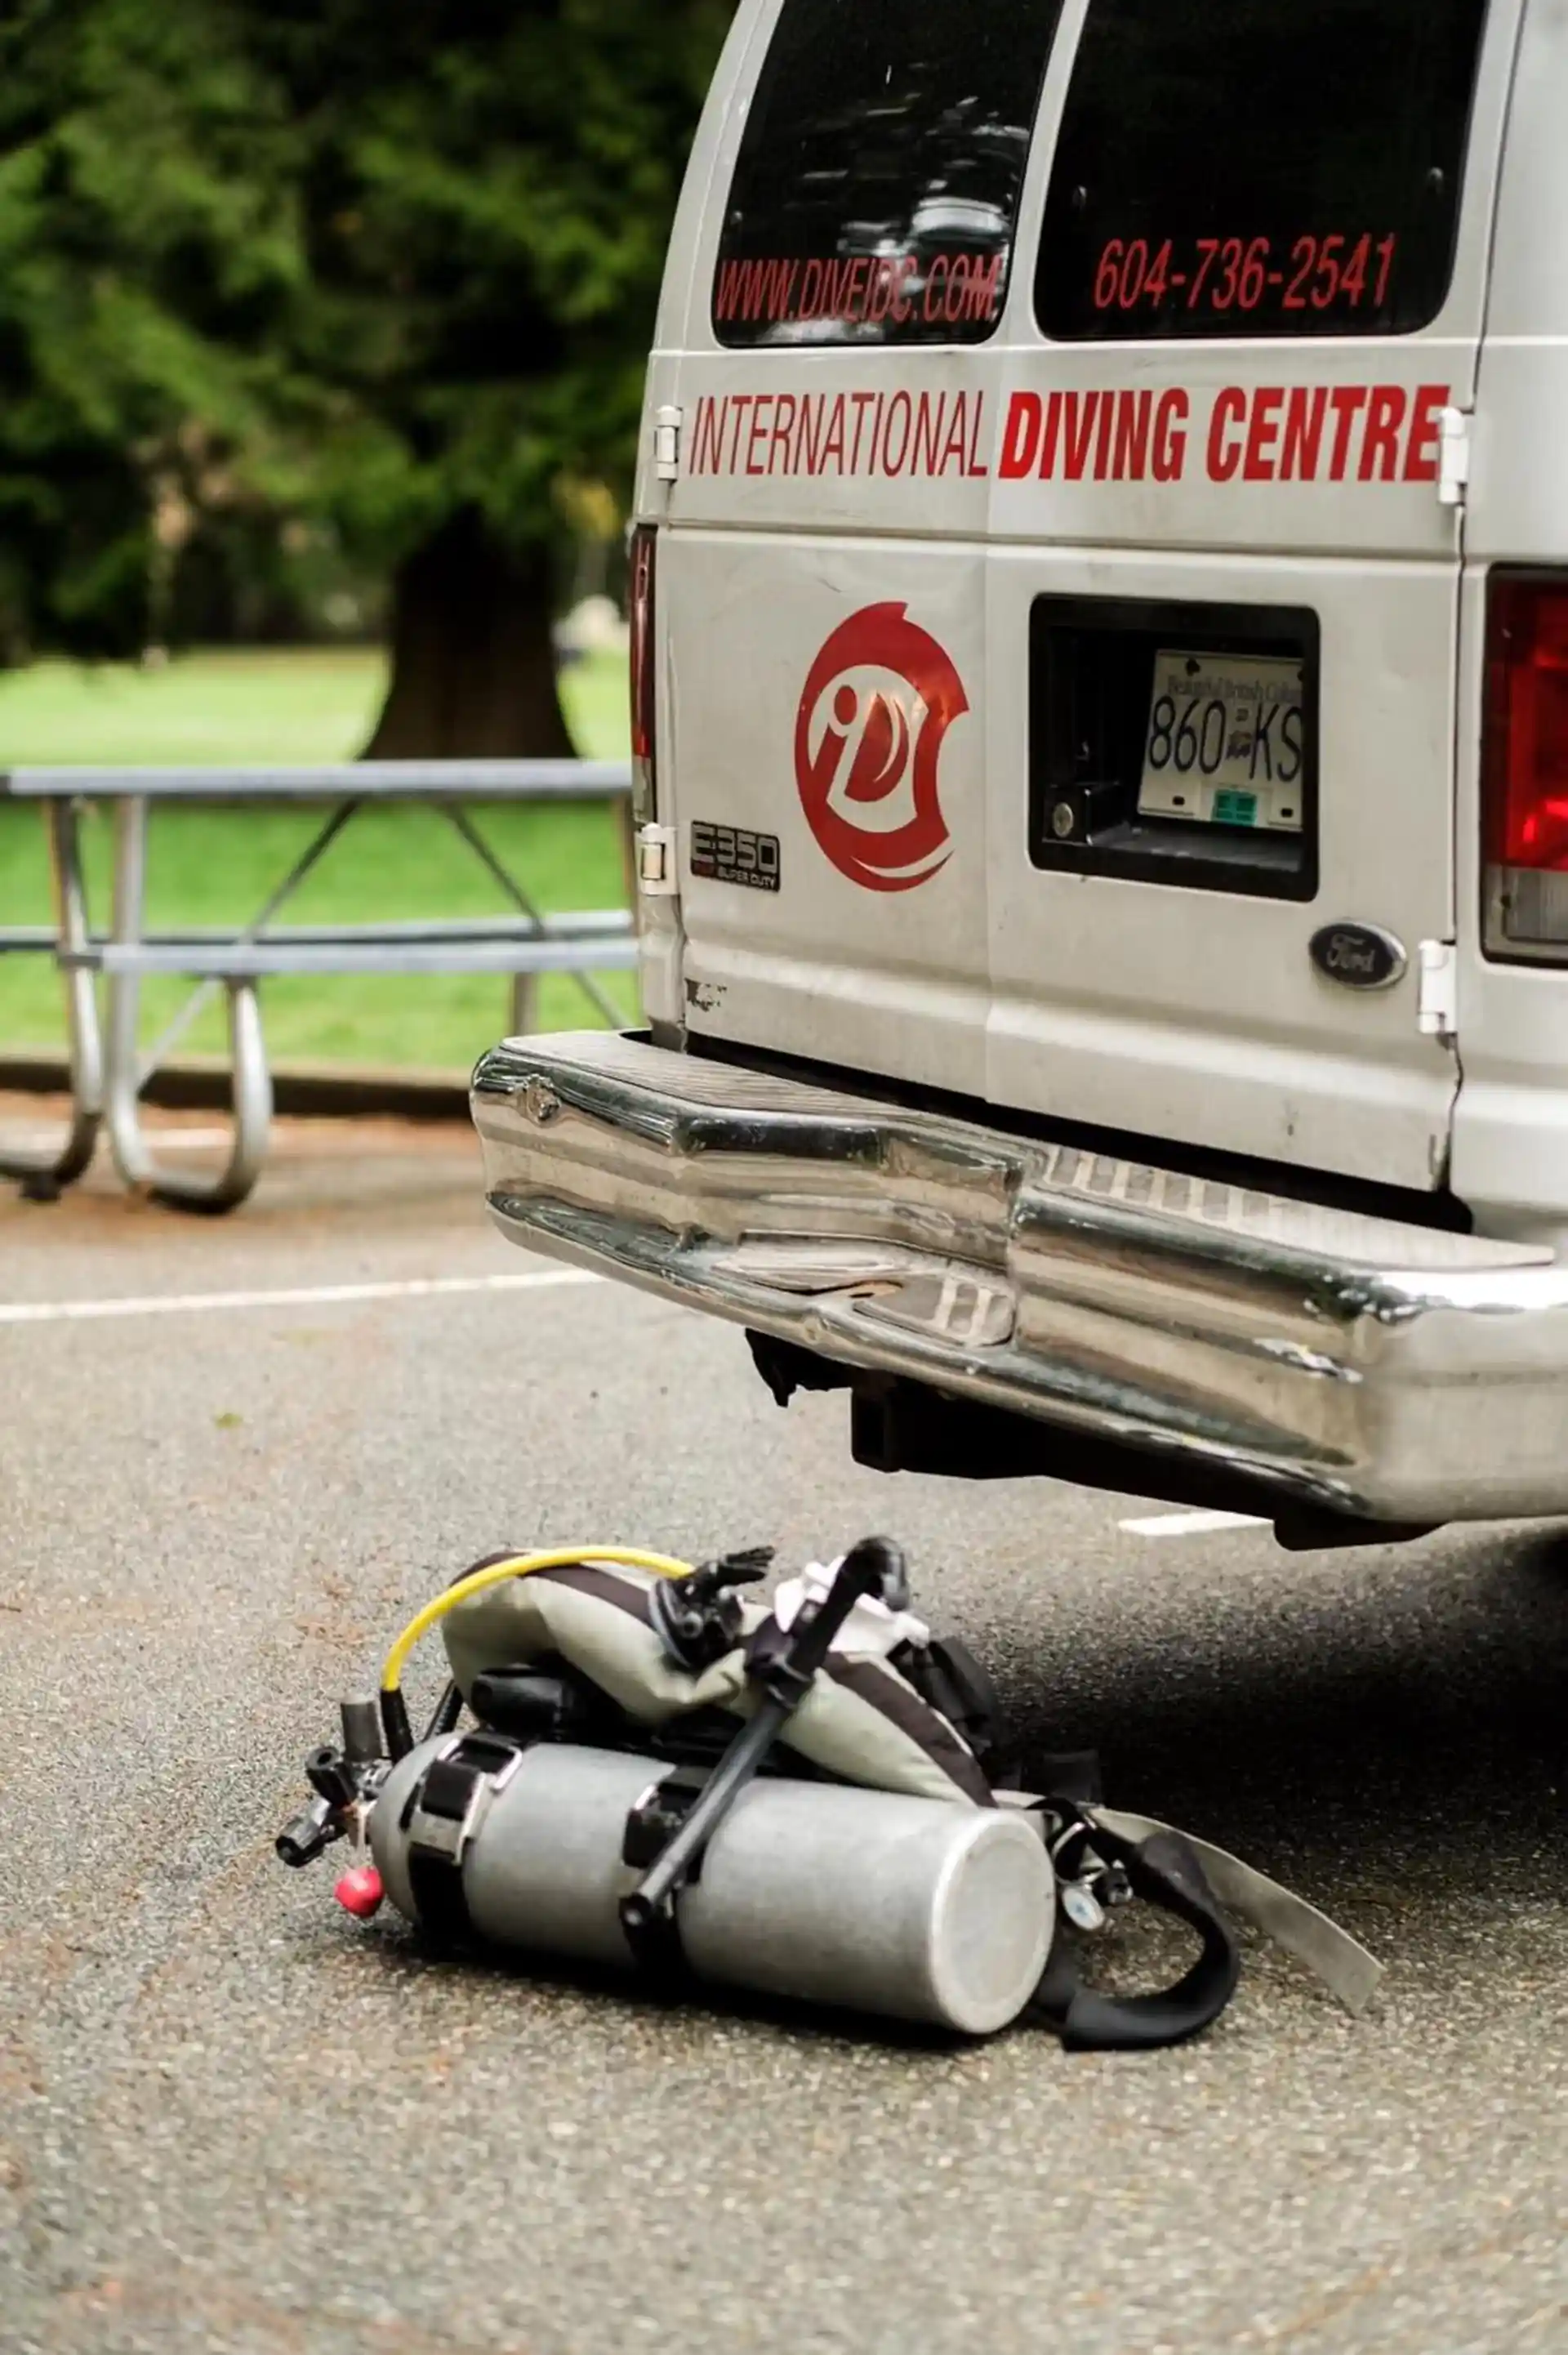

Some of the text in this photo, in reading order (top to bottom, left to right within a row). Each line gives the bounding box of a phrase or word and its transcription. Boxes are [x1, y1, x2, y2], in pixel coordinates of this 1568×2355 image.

[716, 254, 1003, 322] WWW.DIVEIDC.COM
[1094, 233, 1397, 309] 604-736-2541
[689, 384, 1451, 483] INTERNATIONAL DIVING CENTRE
[1149, 695, 1226, 774] 860
[692, 822, 778, 875] E350
